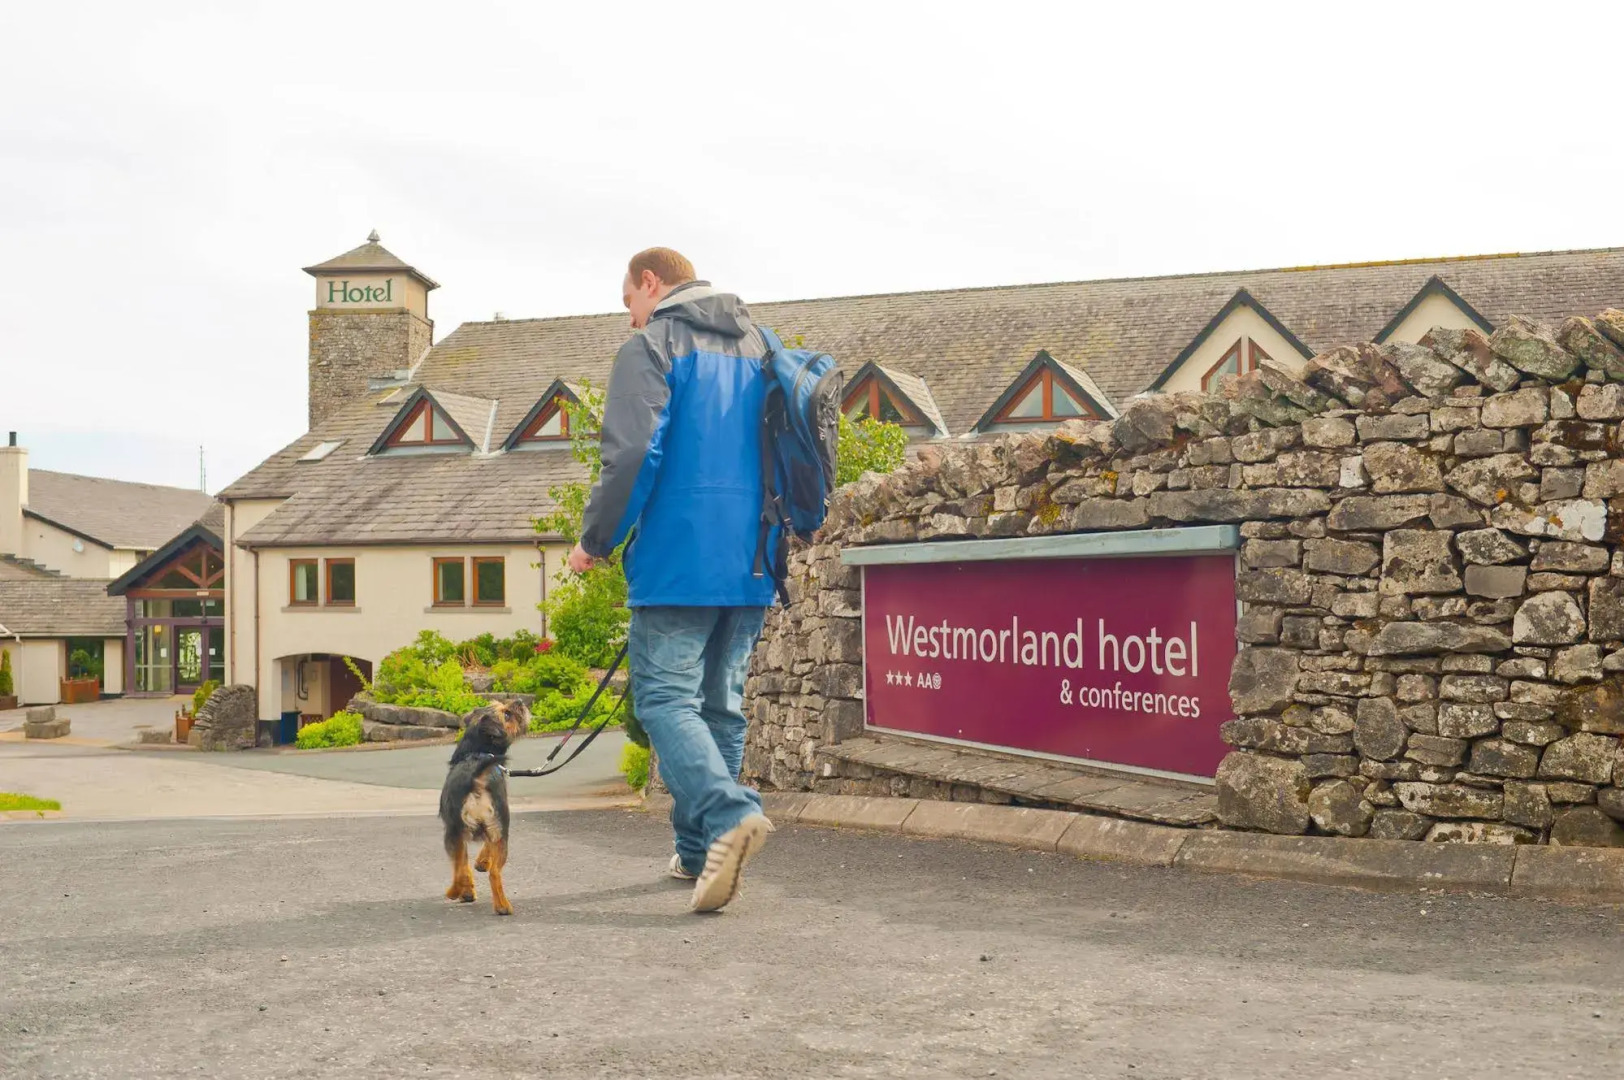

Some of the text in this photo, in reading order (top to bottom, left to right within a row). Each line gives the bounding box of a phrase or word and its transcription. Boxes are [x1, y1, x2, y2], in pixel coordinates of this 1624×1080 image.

[327, 278, 393, 303] Hotel
[886, 614, 1199, 678] Westmorland hotel
[1060, 679, 1201, 719] & conferences
